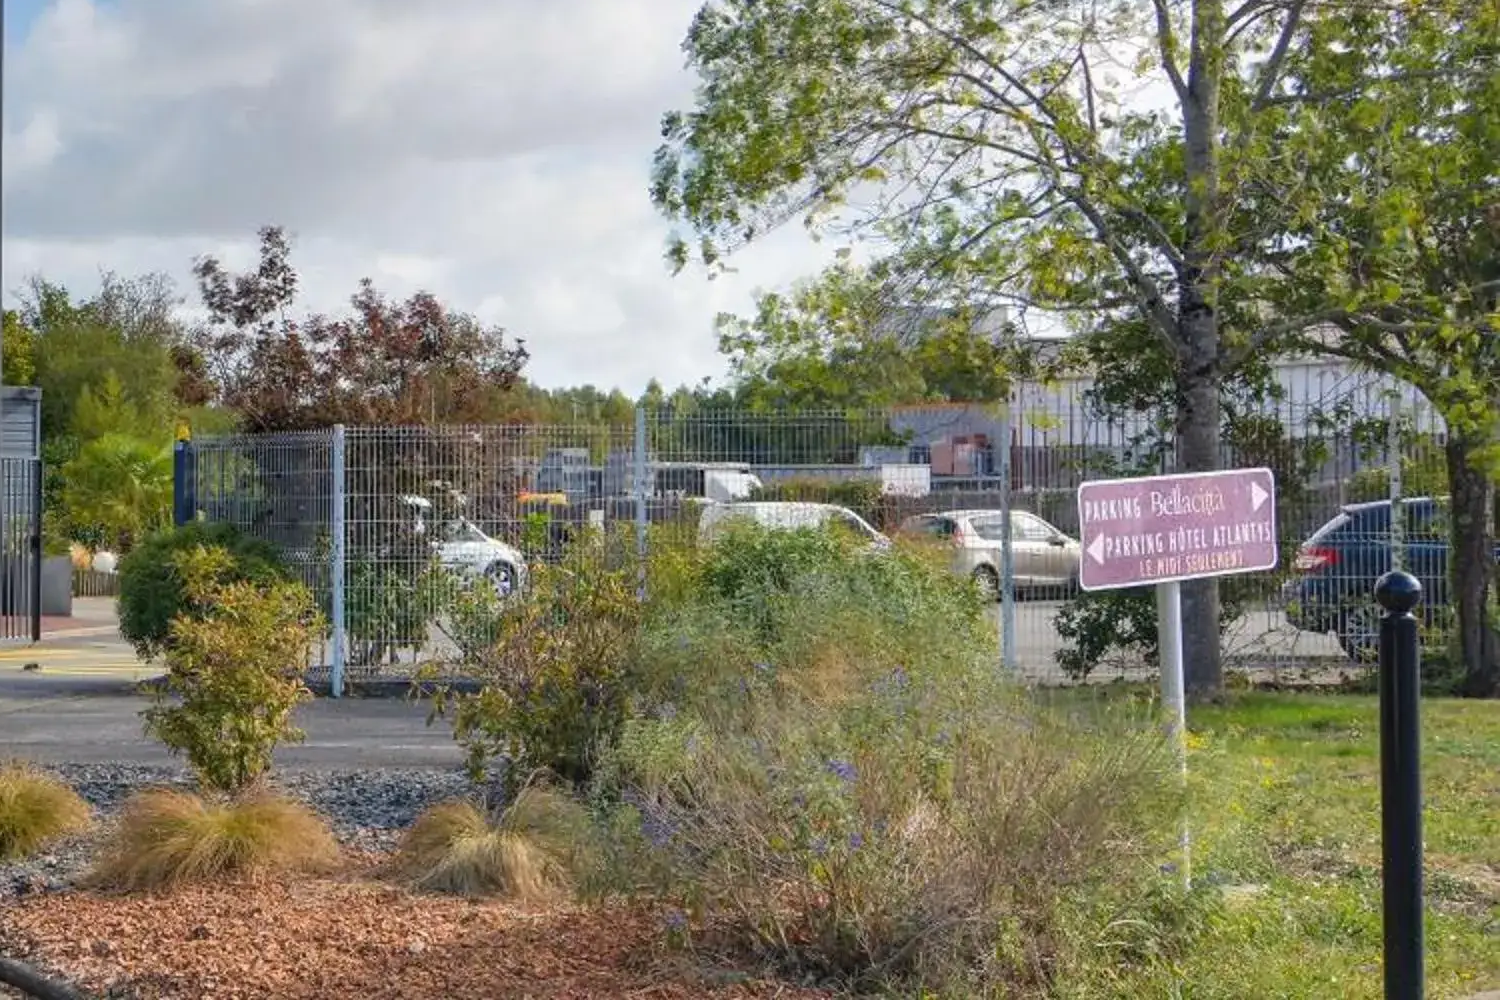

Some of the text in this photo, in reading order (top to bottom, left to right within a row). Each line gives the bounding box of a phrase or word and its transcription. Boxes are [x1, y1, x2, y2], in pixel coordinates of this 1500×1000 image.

[1084, 496, 1141, 522] PARKING
[1105, 521, 1270, 559] PARKING HÔTEL ATLANTYS
